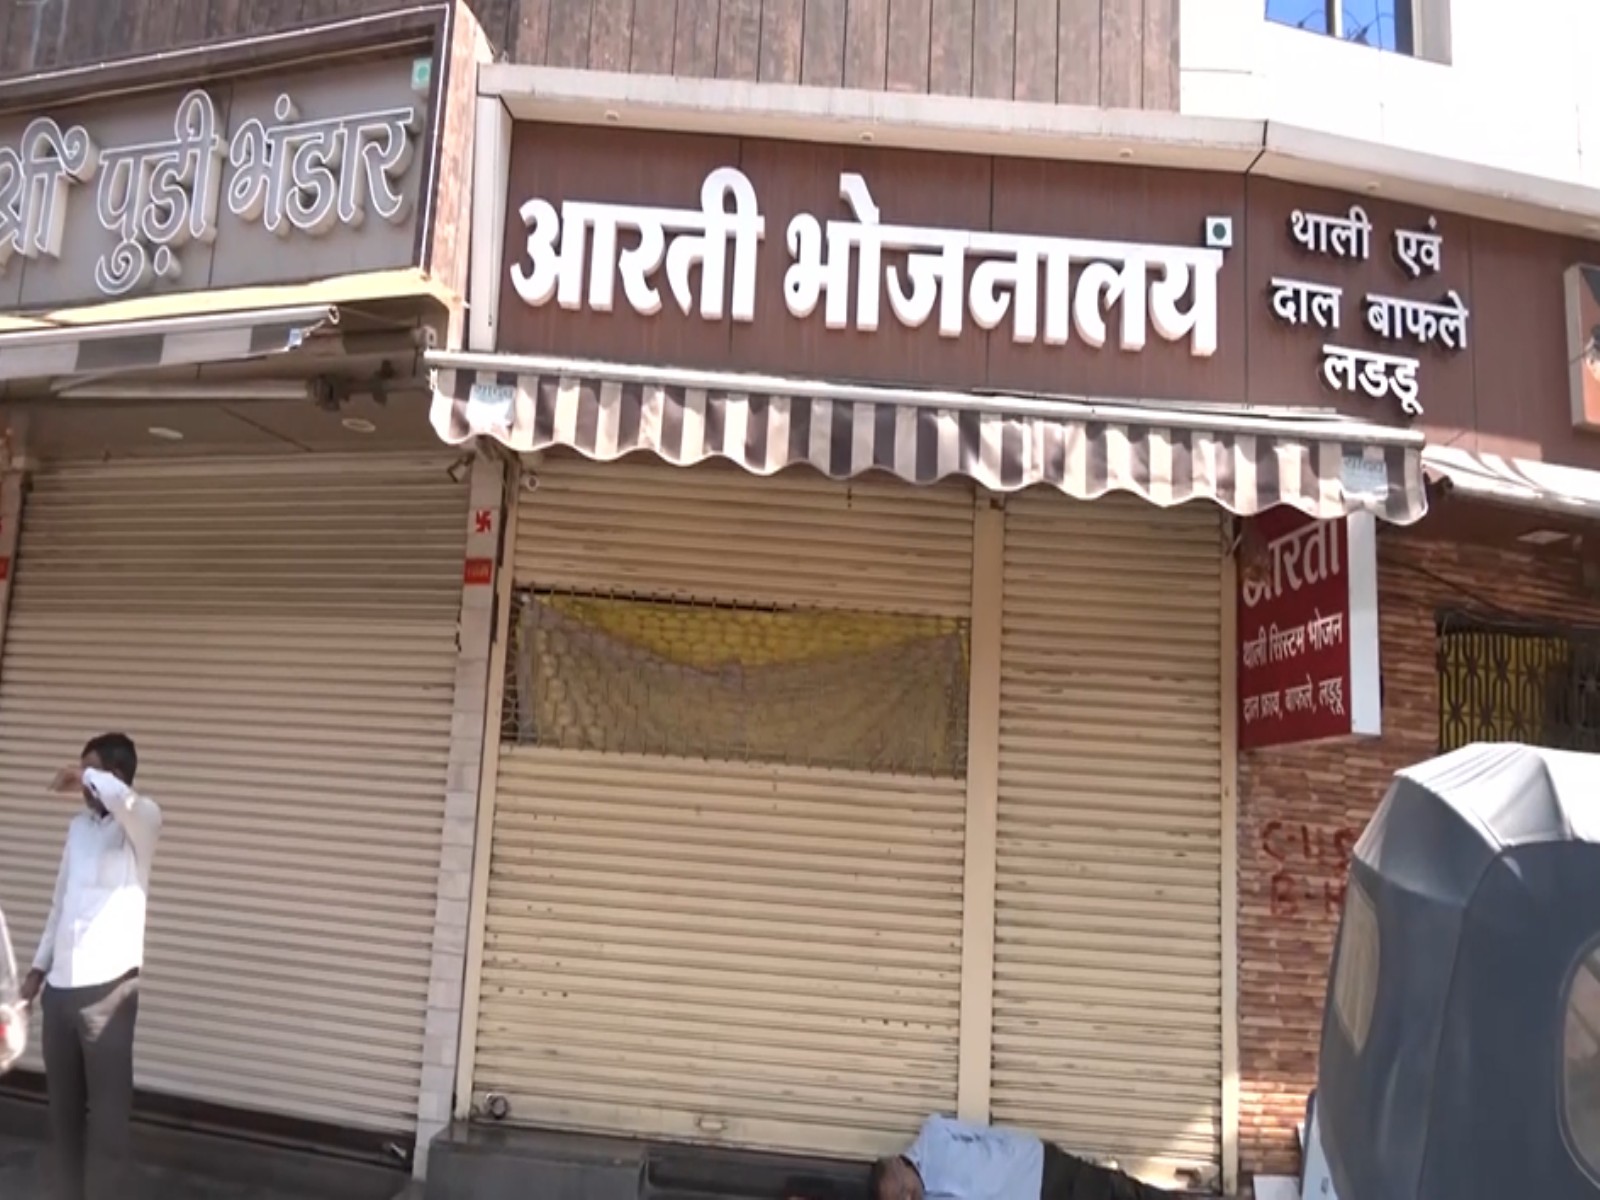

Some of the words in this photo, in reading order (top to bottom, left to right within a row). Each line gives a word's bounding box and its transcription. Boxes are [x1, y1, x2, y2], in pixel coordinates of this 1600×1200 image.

[228, 93, 414, 231] भंडार
[510, 166, 765, 322] आरती
[783, 171, 1223, 356] भोजनालय
[1291, 205, 1372, 259] थाली
[1395, 215, 1442, 276] एवं
[1271, 277, 1343, 328] दाल
[1365, 290, 1469, 349] बाफले
[1307, 607, 1343, 651] भोजन
